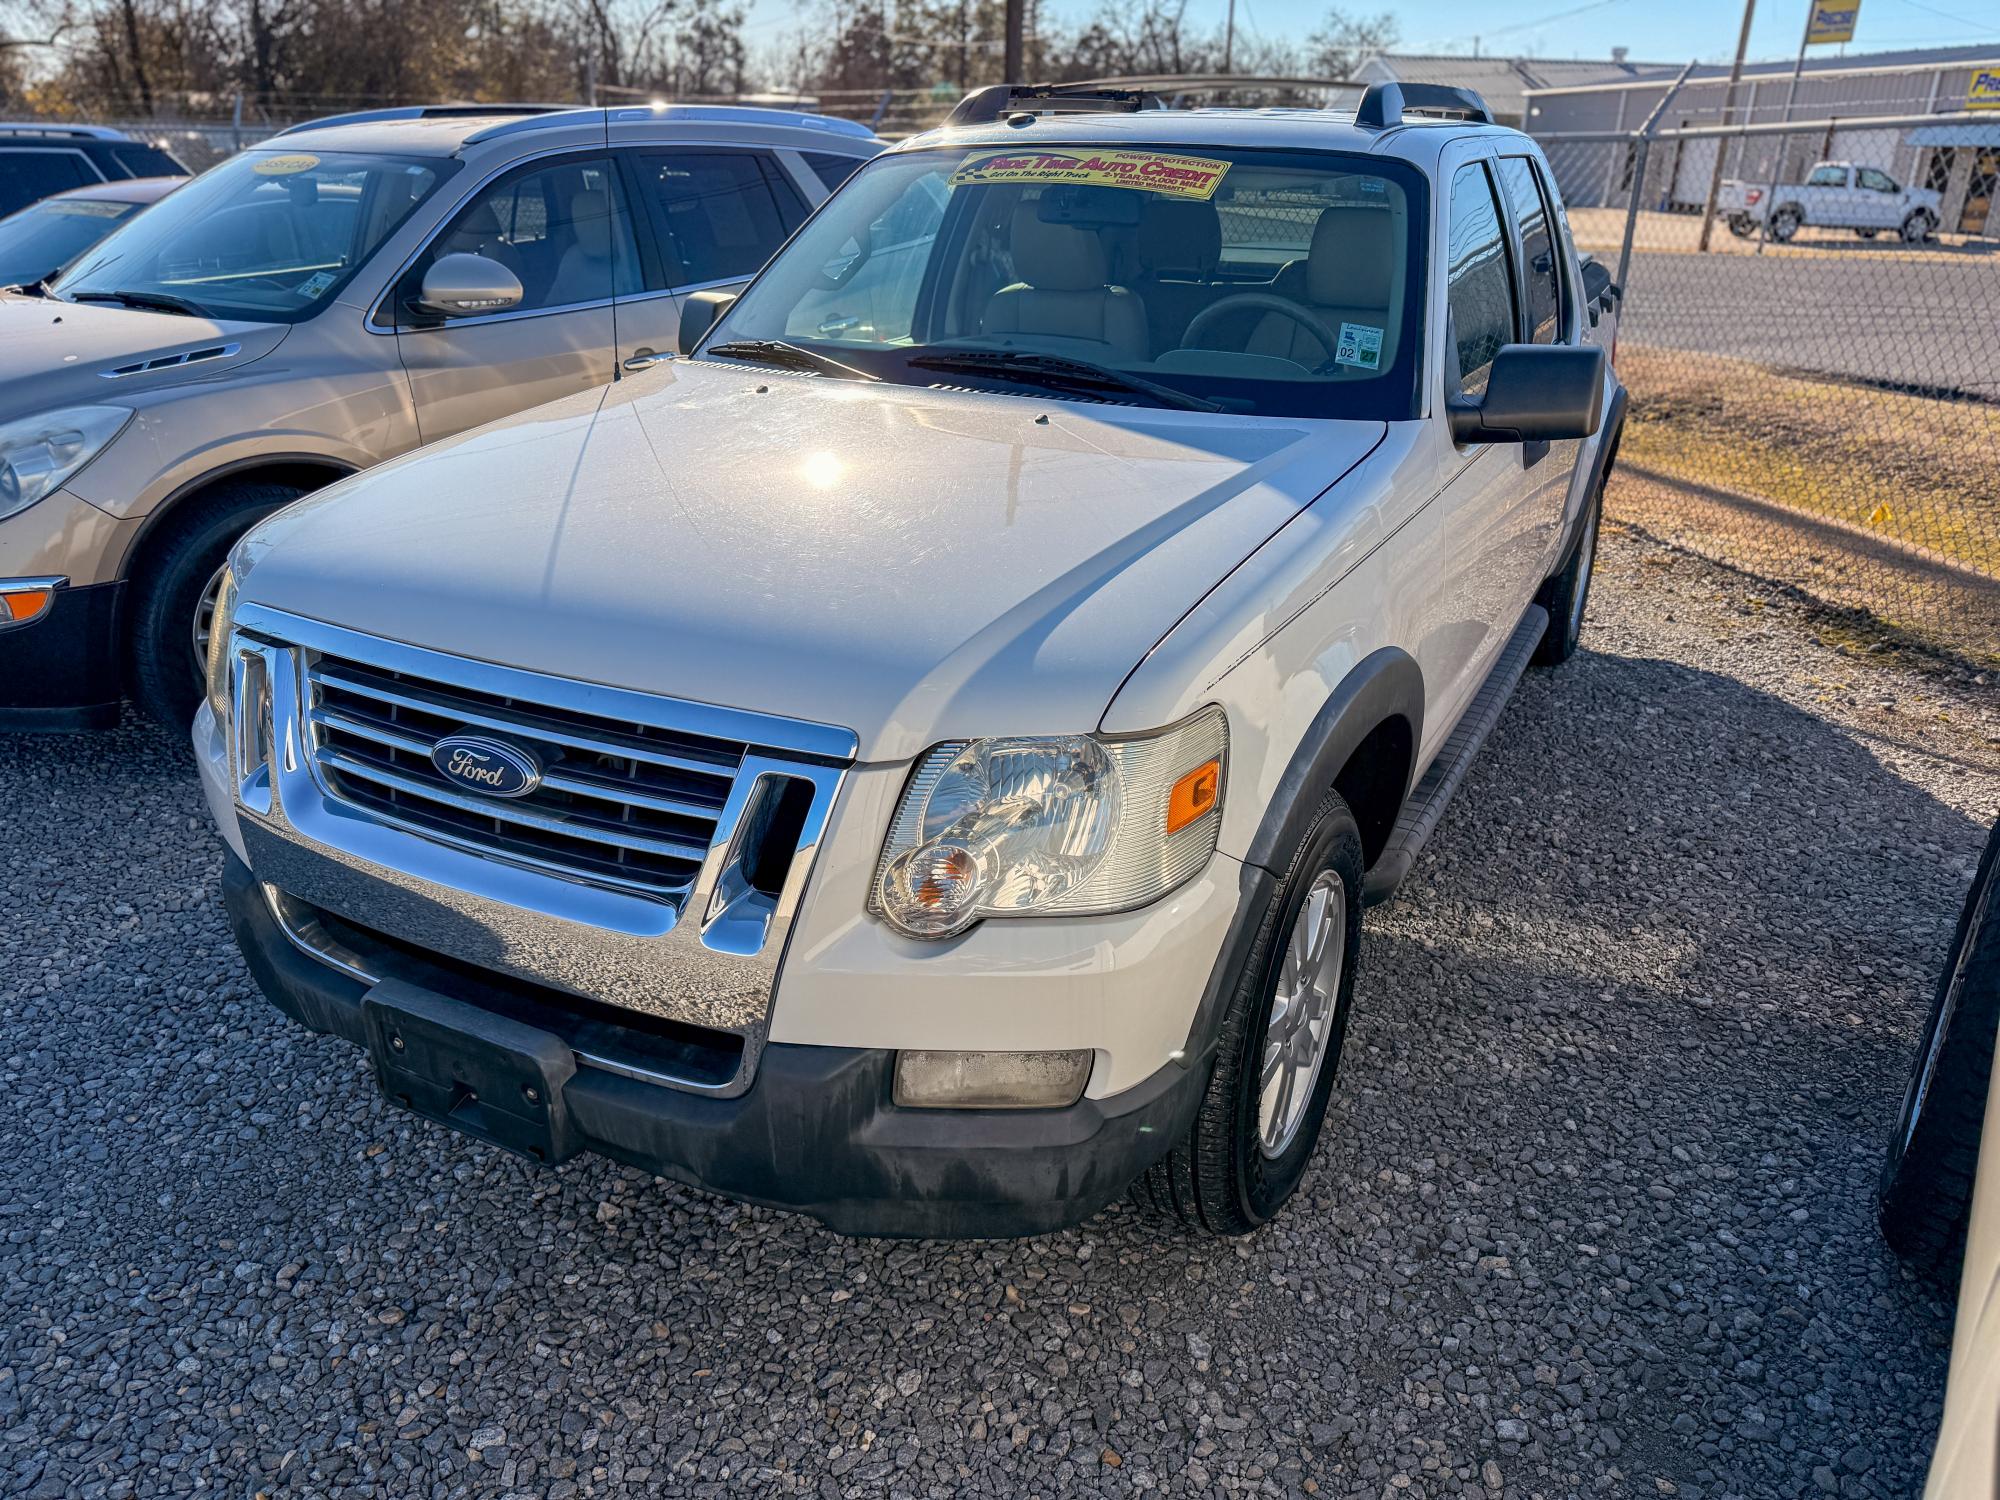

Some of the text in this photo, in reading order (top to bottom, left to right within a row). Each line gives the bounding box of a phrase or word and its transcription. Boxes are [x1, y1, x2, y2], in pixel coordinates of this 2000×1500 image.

[1115, 153, 1221, 170] POWER PROTECTION
[983, 156, 1217, 183] RIDE TIME AUTO CREDIT
[1037, 170, 1062, 178] Right
[1103, 172, 1208, 190] 2-YEAR/24,000 MILE
[1115, 179, 1186, 192] LIMITED WARRANTY
[1340, 347, 1355, 359] 02
[1362, 351, 1376, 362] 27
[448, 748, 504, 786] Ford
